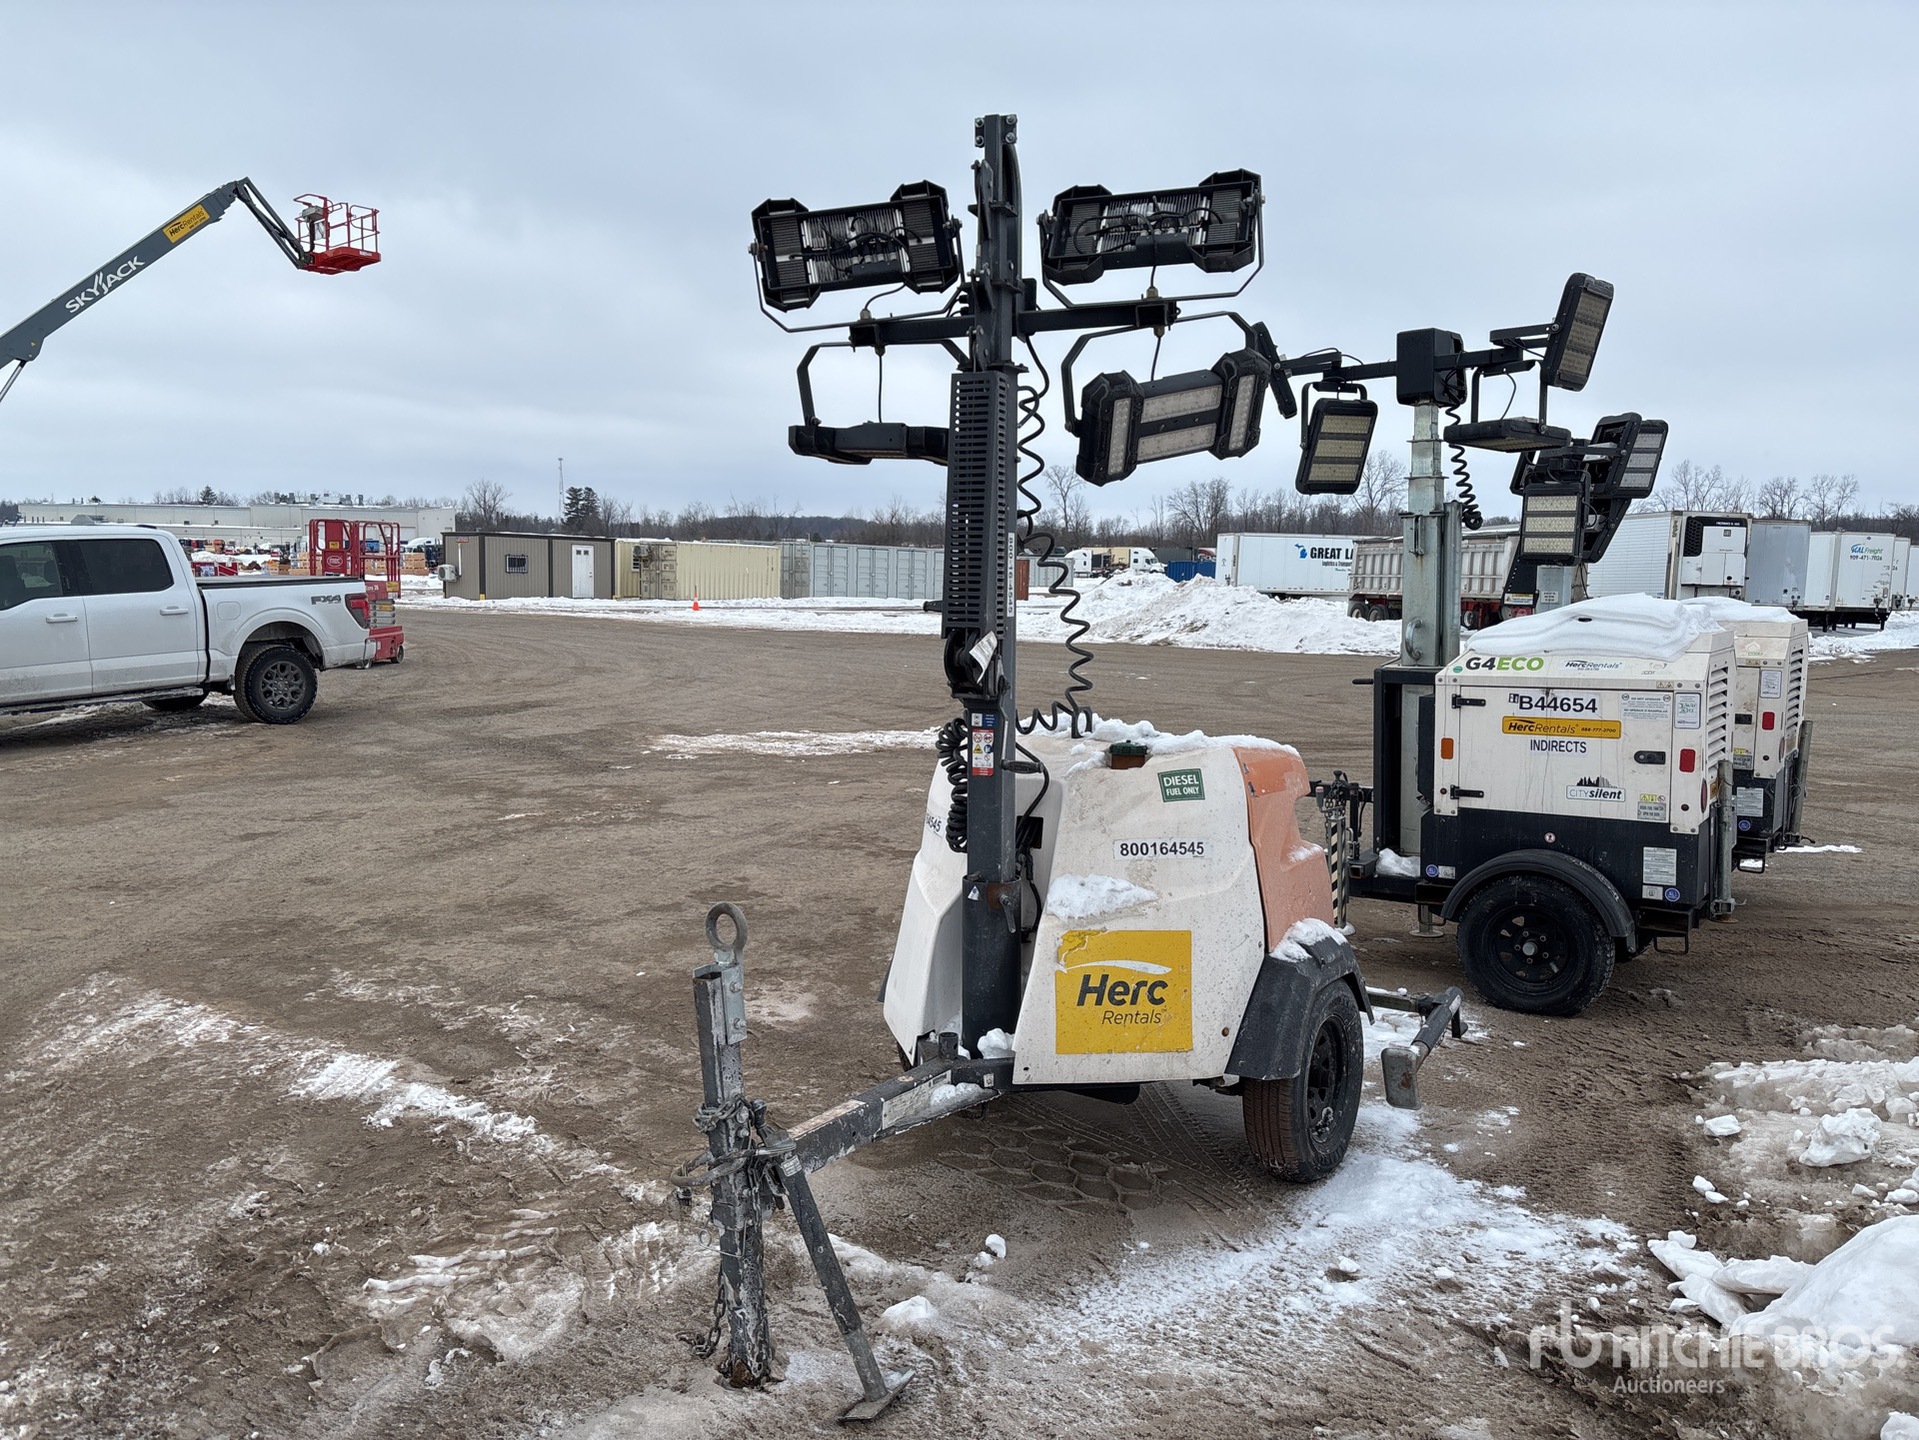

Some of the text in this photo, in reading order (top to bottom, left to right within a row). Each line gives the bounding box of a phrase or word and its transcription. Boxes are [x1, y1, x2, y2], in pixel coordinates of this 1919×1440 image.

[65, 255, 145, 313] SKYJACK
[1310, 547, 1342, 559] GREAT
[311, 594, 342, 605] FX4
[1465, 656, 1544, 671] G4ECO
[1518, 695, 1598, 713] B44654
[1530, 739, 1587, 753] INDIRECTS
[1163, 774, 1199, 787] DIESEL
[1166, 786, 1199, 796] FUEL ONLY
[1120, 841, 1204, 856] 800164545
[1076, 973, 1169, 1006] Herc
[1101, 1009, 1162, 1025] Rentals
